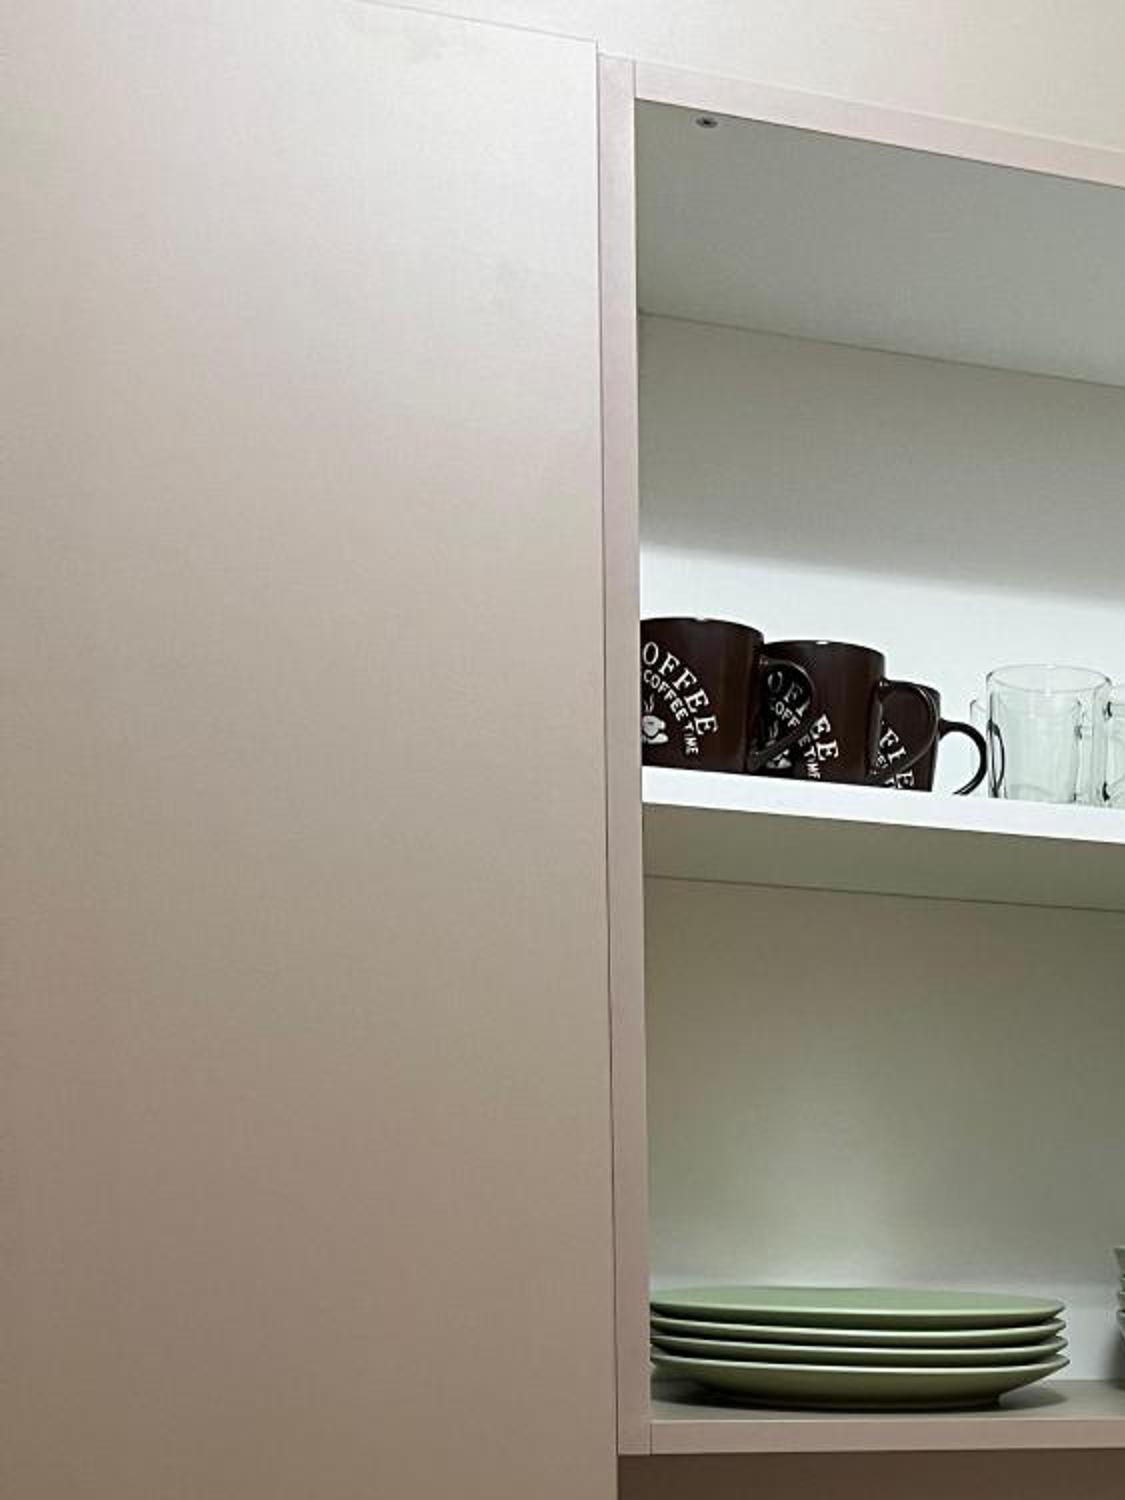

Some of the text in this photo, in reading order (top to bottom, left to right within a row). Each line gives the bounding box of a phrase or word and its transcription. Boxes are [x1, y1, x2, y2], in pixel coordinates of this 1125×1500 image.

[643, 641, 719, 735] OFFEE
[643, 669, 699, 755] COFFEE TIME
